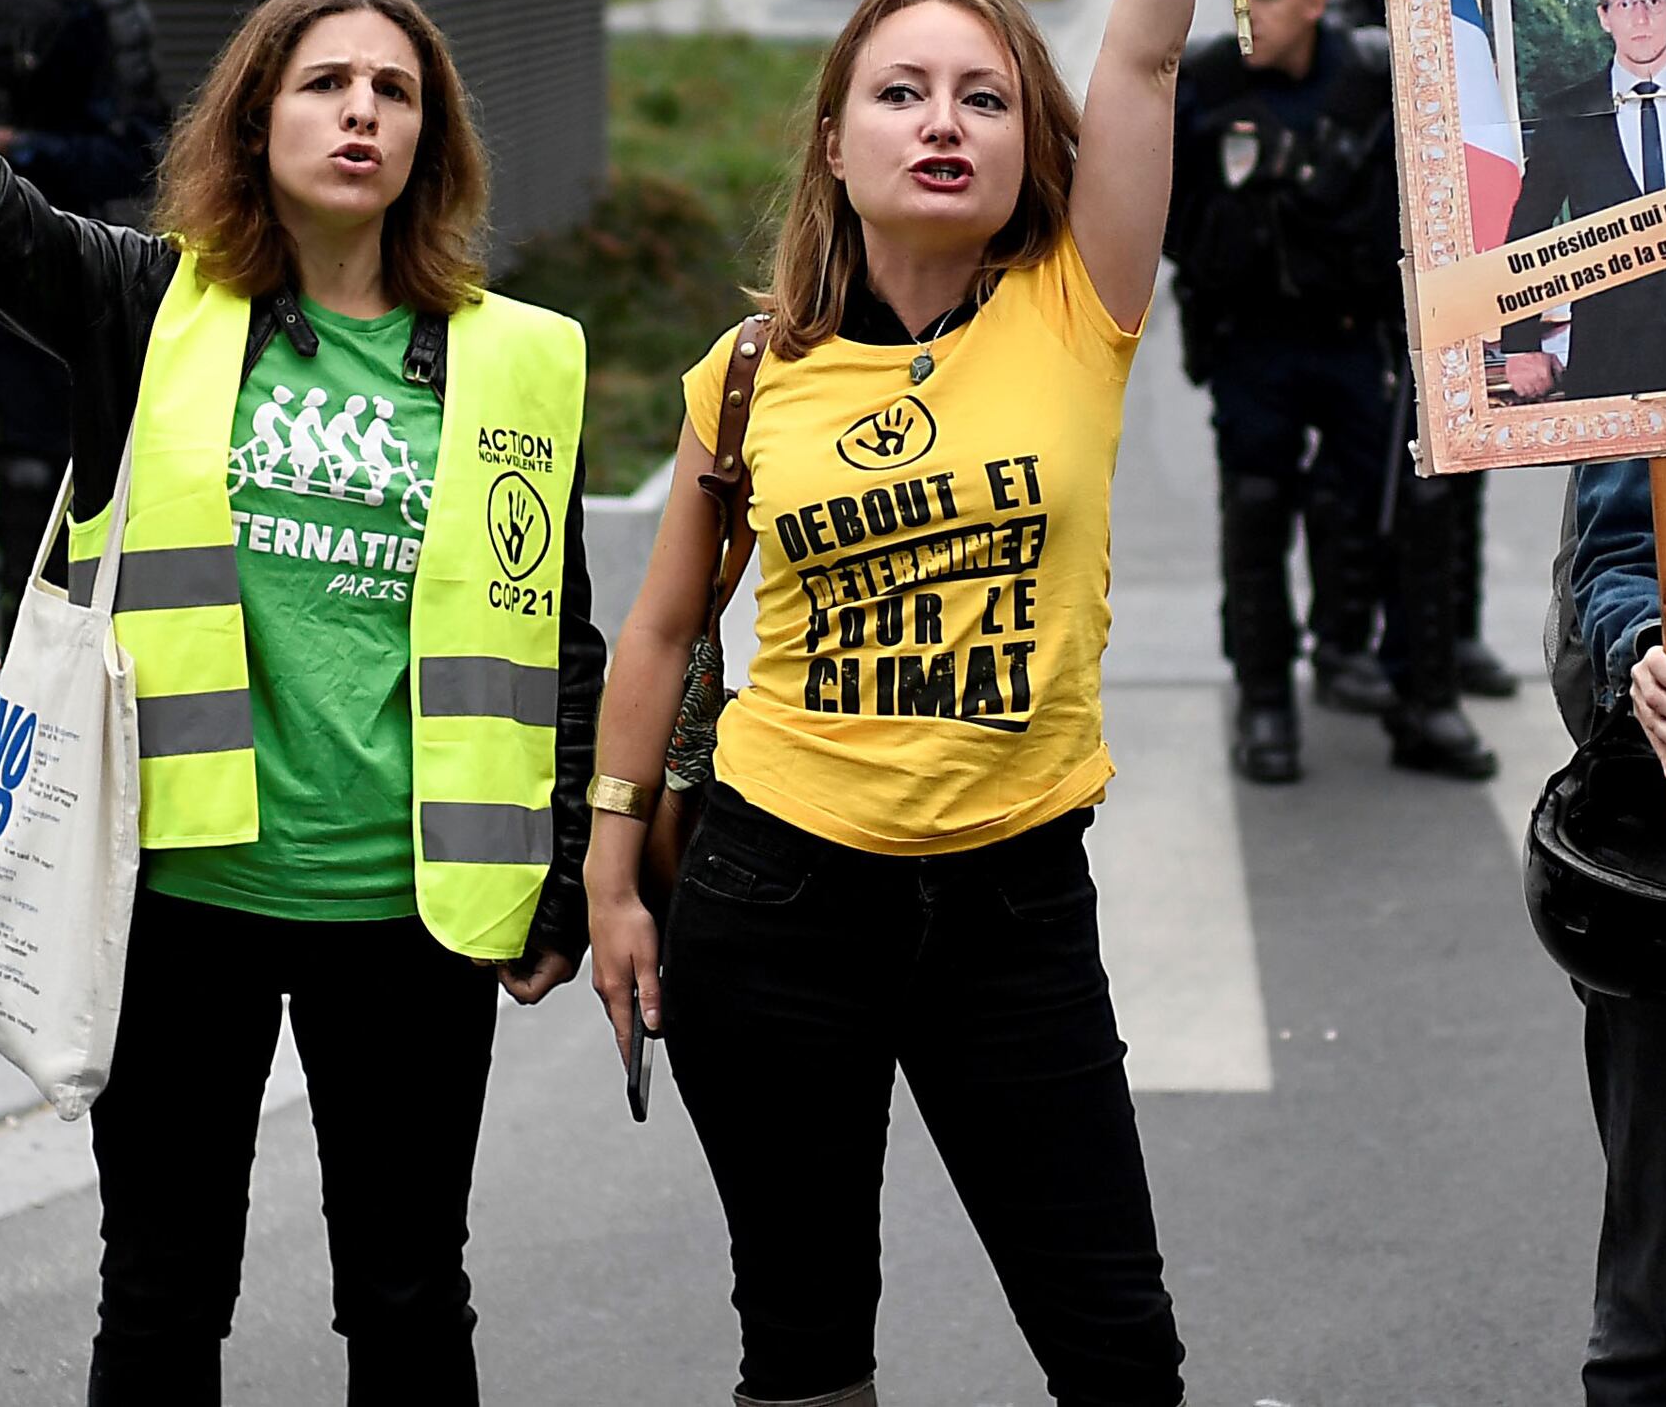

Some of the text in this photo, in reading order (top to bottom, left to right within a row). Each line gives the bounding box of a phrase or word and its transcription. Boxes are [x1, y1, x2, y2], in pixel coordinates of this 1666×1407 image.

[1507, 252, 1535, 275] Un
[1537, 218, 1627, 268] président
[1631, 203, 1662, 232] qui
[1496, 272, 1571, 314] foutrait
[1573, 262, 1606, 290] pas
[1607, 249, 1633, 276] de
[1636, 244, 1655, 267] la
[478, 427, 552, 460] ACTION
[478, 449, 553, 473] NON-VIOLENTE
[775, 455, 1042, 563] DEBOUT ET
[326, 574, 409, 602] PARIS
[489, 581, 553, 616] COP21
[806, 579, 1037, 654] POUR LE
[804, 639, 1036, 718] CLIMAT
